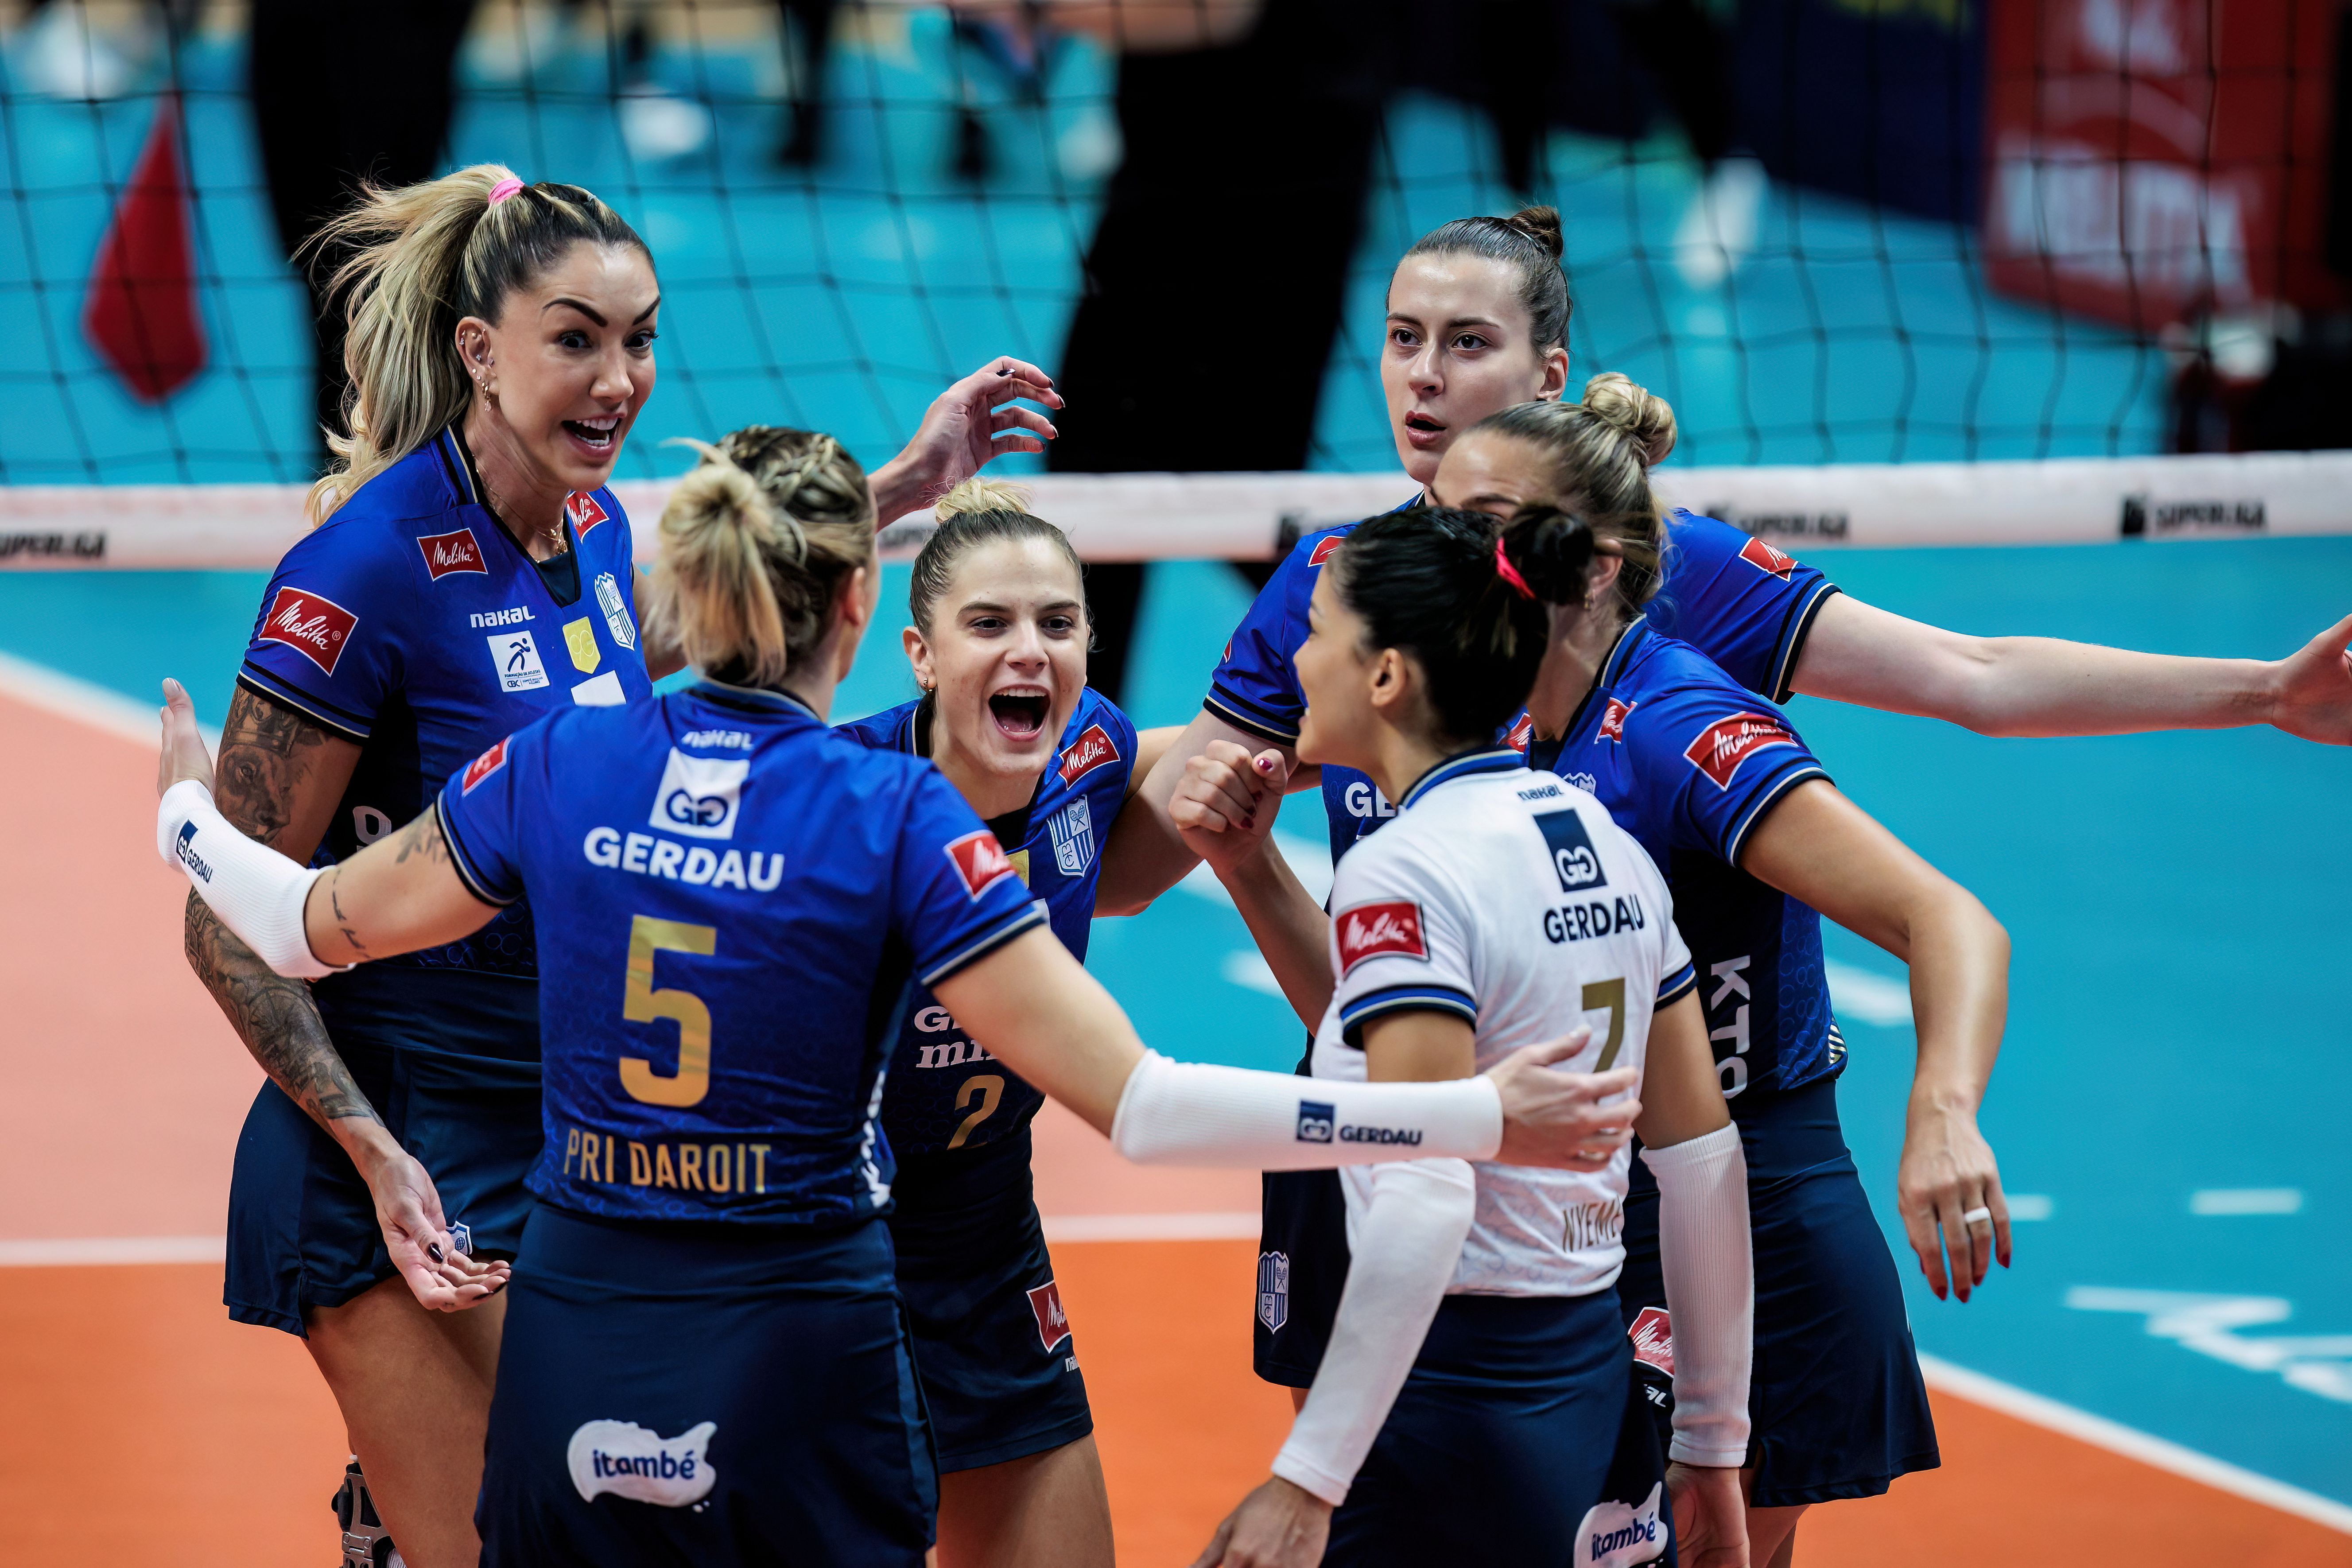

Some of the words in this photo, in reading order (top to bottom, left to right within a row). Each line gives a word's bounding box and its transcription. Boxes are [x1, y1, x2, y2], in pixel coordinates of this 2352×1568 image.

[433, 541, 474, 567] Melitta
[272, 599, 330, 650] Melitta
[1067, 741, 1106, 776] Melitta
[187, 848, 213, 884] GERDAU
[583, 826, 784, 892] GERDAU
[1343, 912, 1409, 951] Melitta
[1544, 893, 1645, 945] GERDAU
[619, 914, 717, 1108] 5
[914, 1006, 963, 1032] G
[1582, 977, 1625, 1074] 7
[1710, 955, 1750, 1099] KTO
[916, 1040, 998, 1068] mi
[947, 1075, 1005, 1150] 2
[1339, 1124, 1423, 1146] GERDAU
[564, 1129, 614, 1184] PRI
[628, 1141, 771, 1194] DAROIT
[592, 1449, 696, 1479] itambé
[1591, 1511, 1657, 1562] itambé
